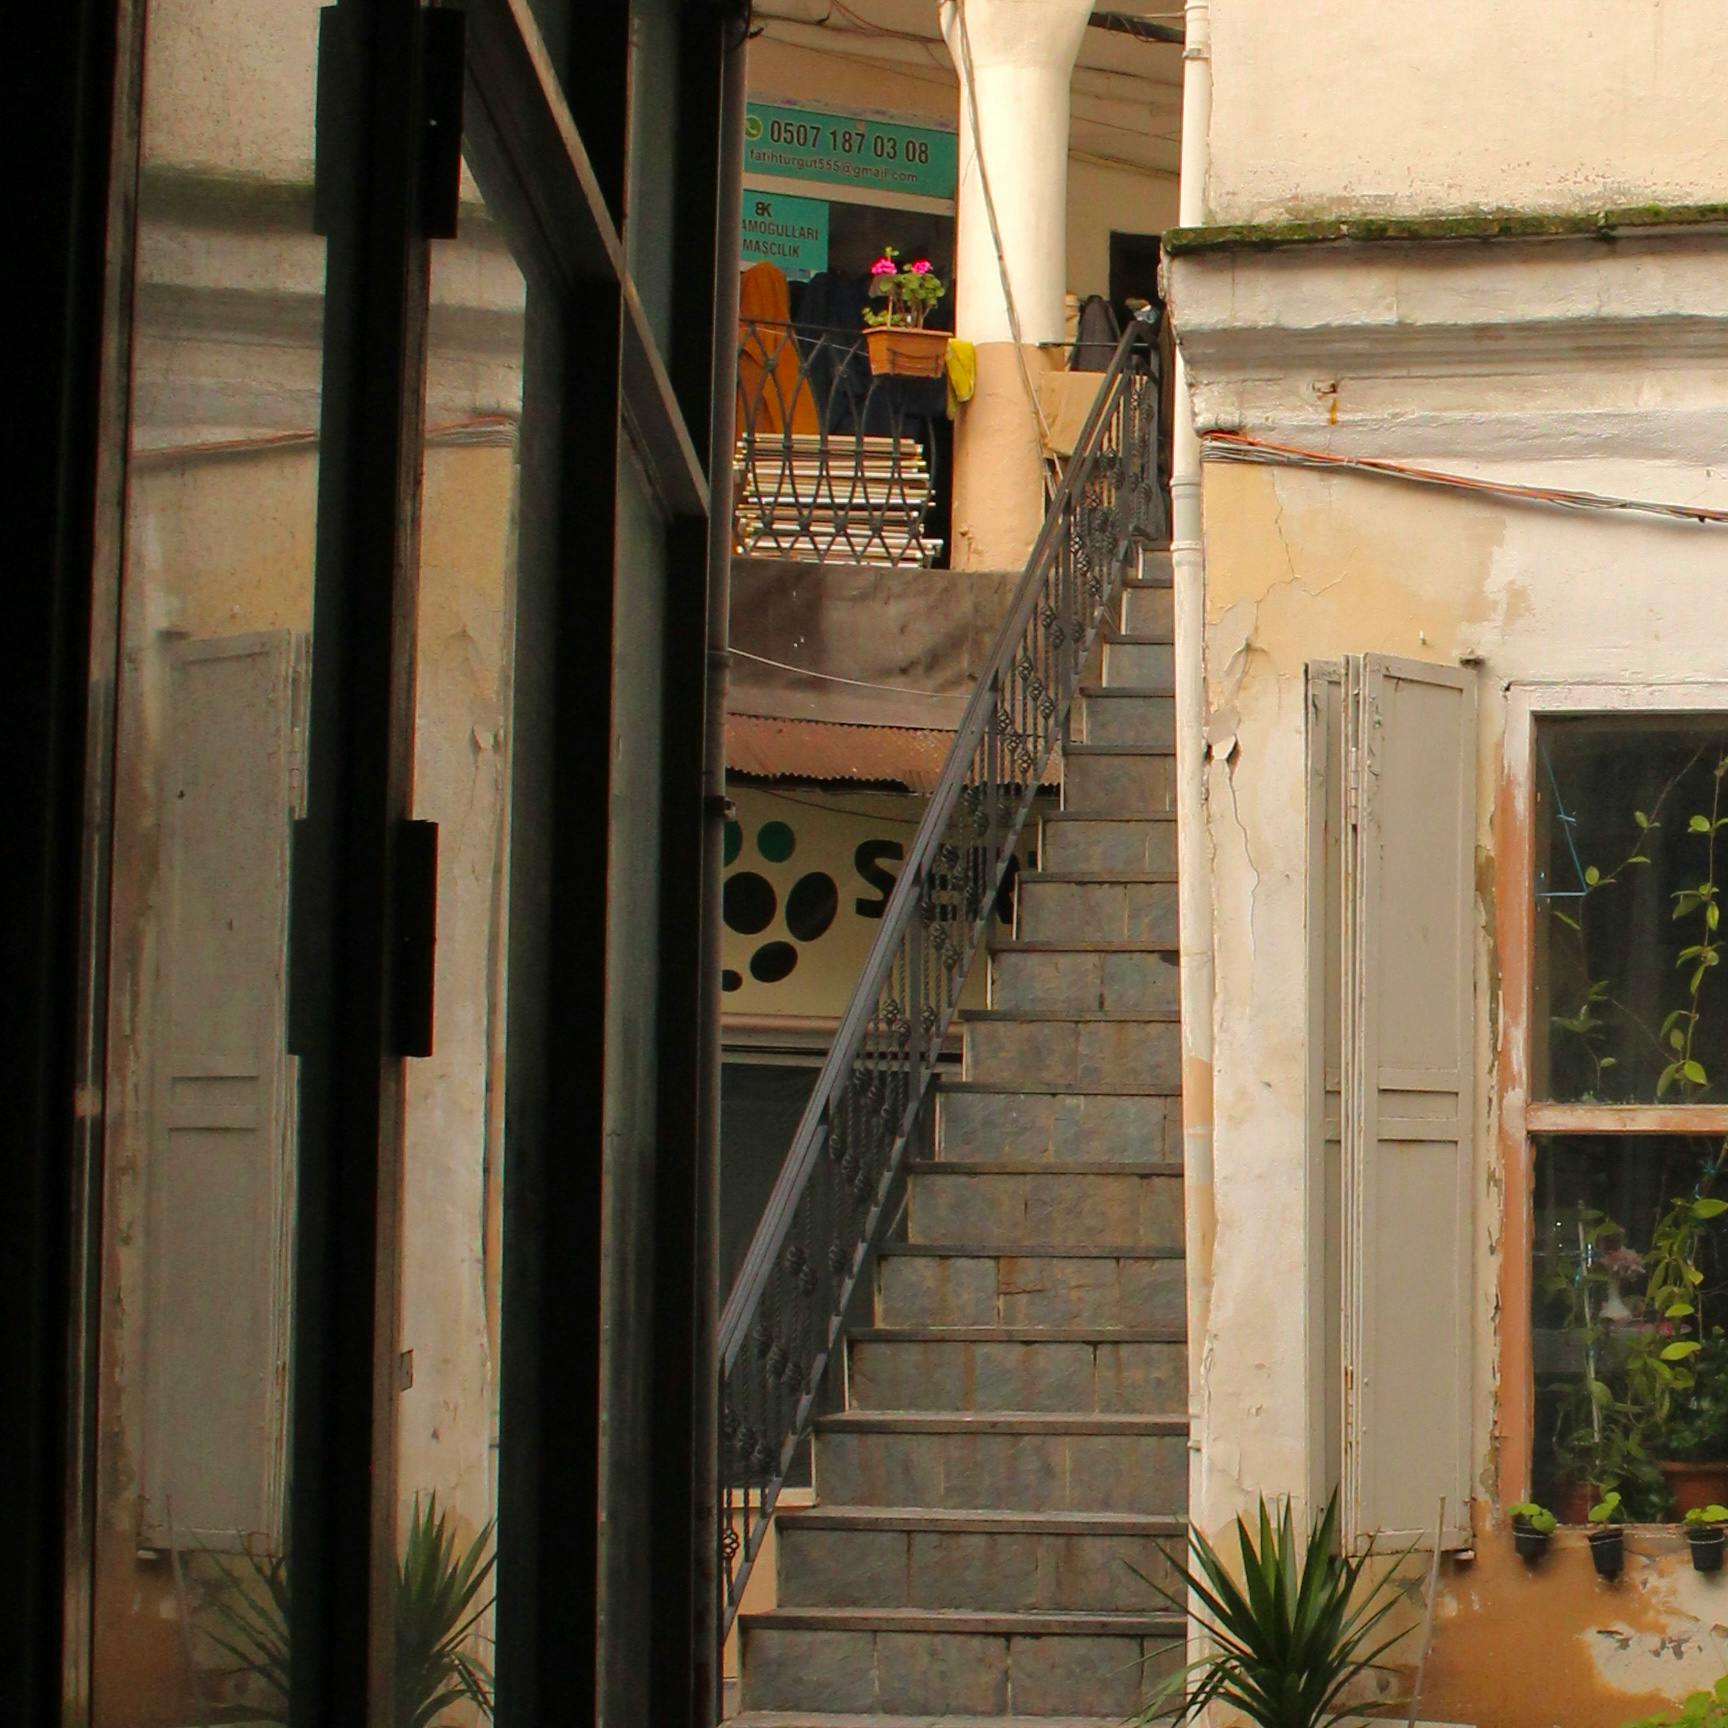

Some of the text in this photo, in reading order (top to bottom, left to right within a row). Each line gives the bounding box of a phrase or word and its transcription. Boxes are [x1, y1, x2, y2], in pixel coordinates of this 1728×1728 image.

[770, 120, 929, 165] 0507 187 03 08
